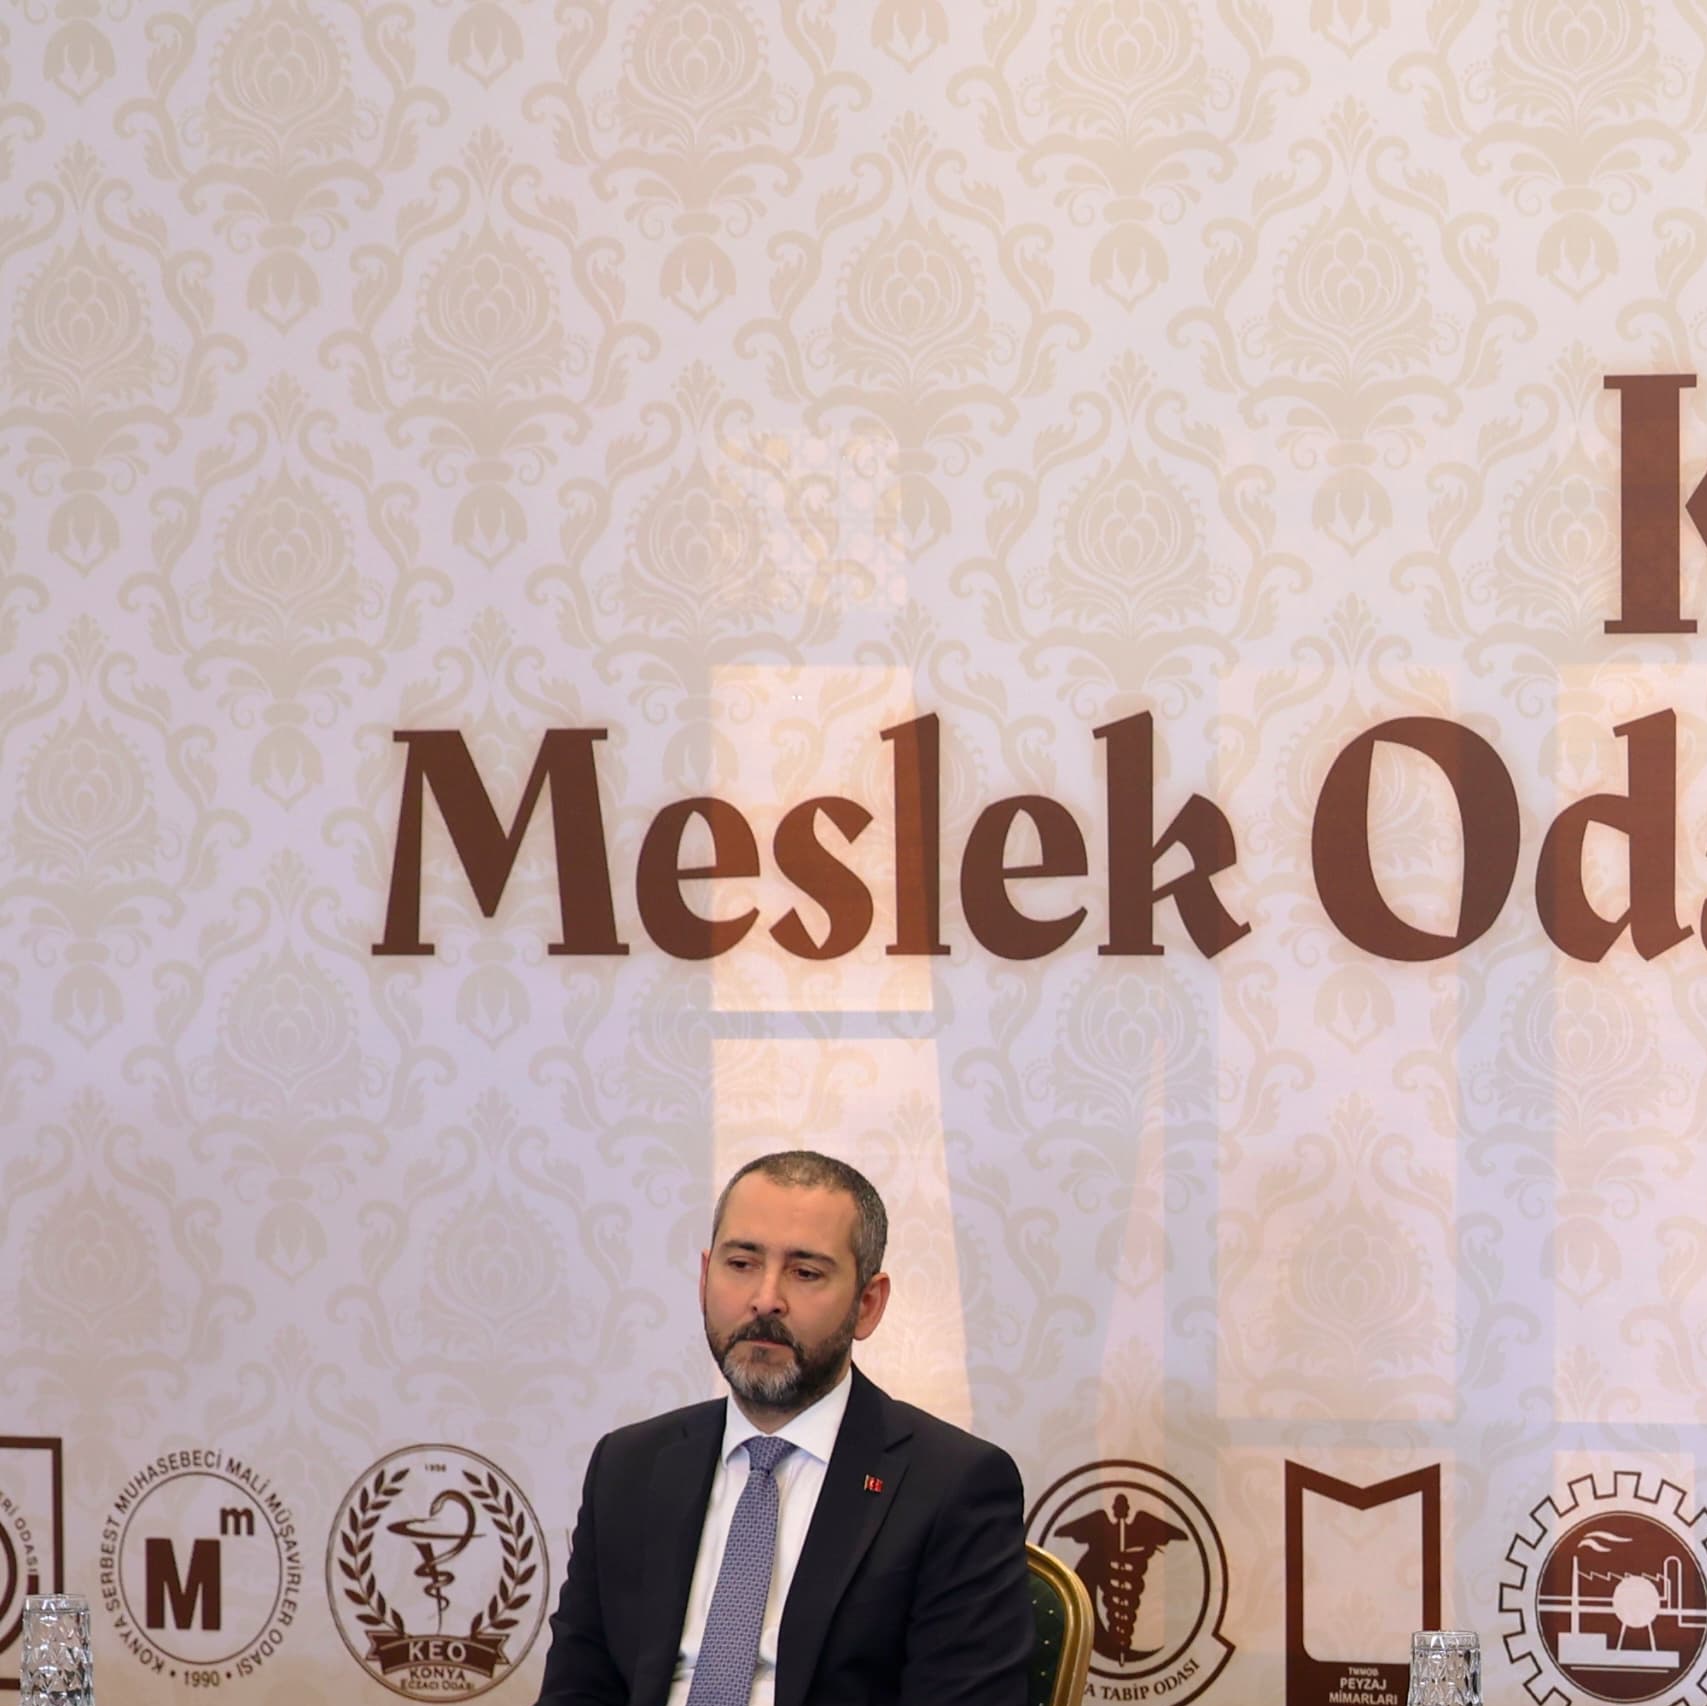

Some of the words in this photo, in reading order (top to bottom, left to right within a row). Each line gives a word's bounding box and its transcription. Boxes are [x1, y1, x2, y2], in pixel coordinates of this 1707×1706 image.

[370, 709, 1252, 963] Meslek
[115, 1449, 223, 1515] MUHASEBECİ
[225, 1457, 271, 1495] MALİ
[100, 1515, 123, 1612] SERBEST
[263, 1493, 304, 1628] MÜŞAVİRLER
[113, 1618, 165, 1675] KONYA
[235, 1627, 284, 1677] ODASI
[409, 1641, 467, 1662] KEO
[183, 1671, 221, 1688] 1990
[410, 1667, 466, 1682] KONYA
[1101, 1683, 1150, 1701] TABİP
[1153, 1658, 1200, 1695] ODASI
[1340, 1678, 1387, 1690] PEYZAJ
[1329, 1690, 1398, 1705] MİMARLARI
